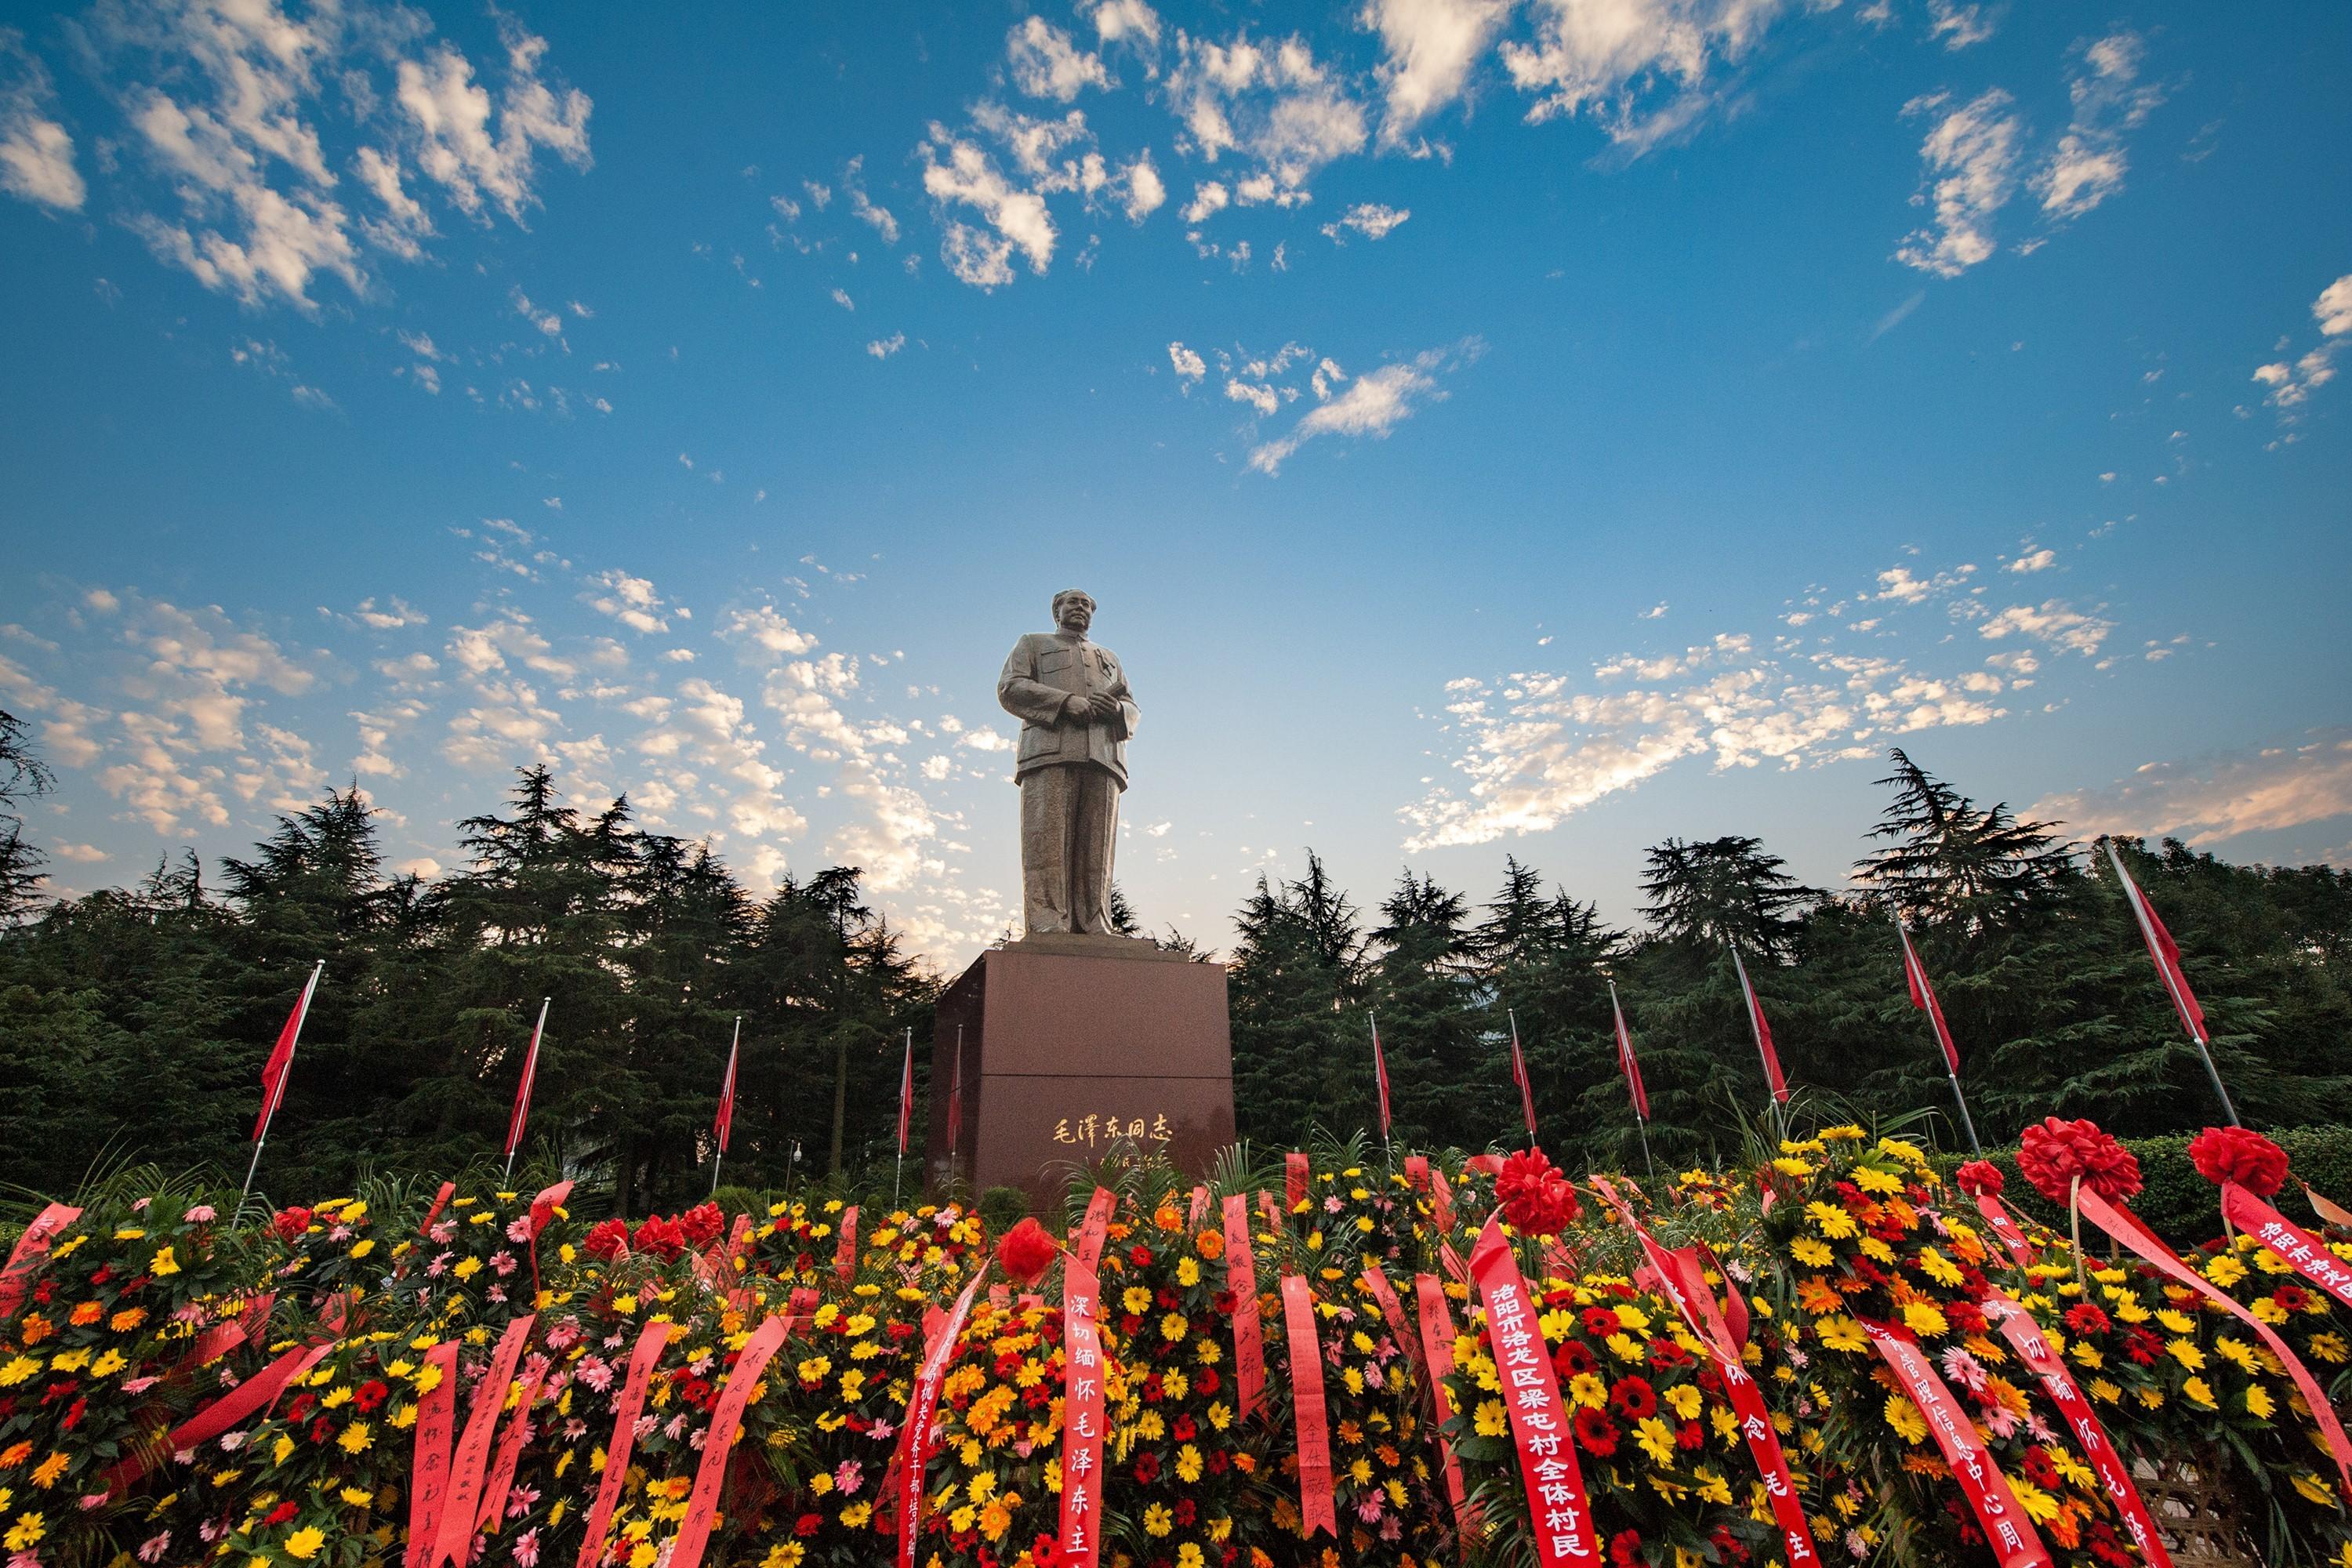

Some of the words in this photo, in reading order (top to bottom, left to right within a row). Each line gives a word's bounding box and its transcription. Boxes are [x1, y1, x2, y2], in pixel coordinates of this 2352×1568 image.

[1065, 1294, 1095, 1568] 深切缅怀毛泽东主
[1490, 1283, 1590, 1559] 洛阳市洛龙区梁屯村全体村民
[1986, 1299, 2158, 1568] 深切缅怀毛泽
